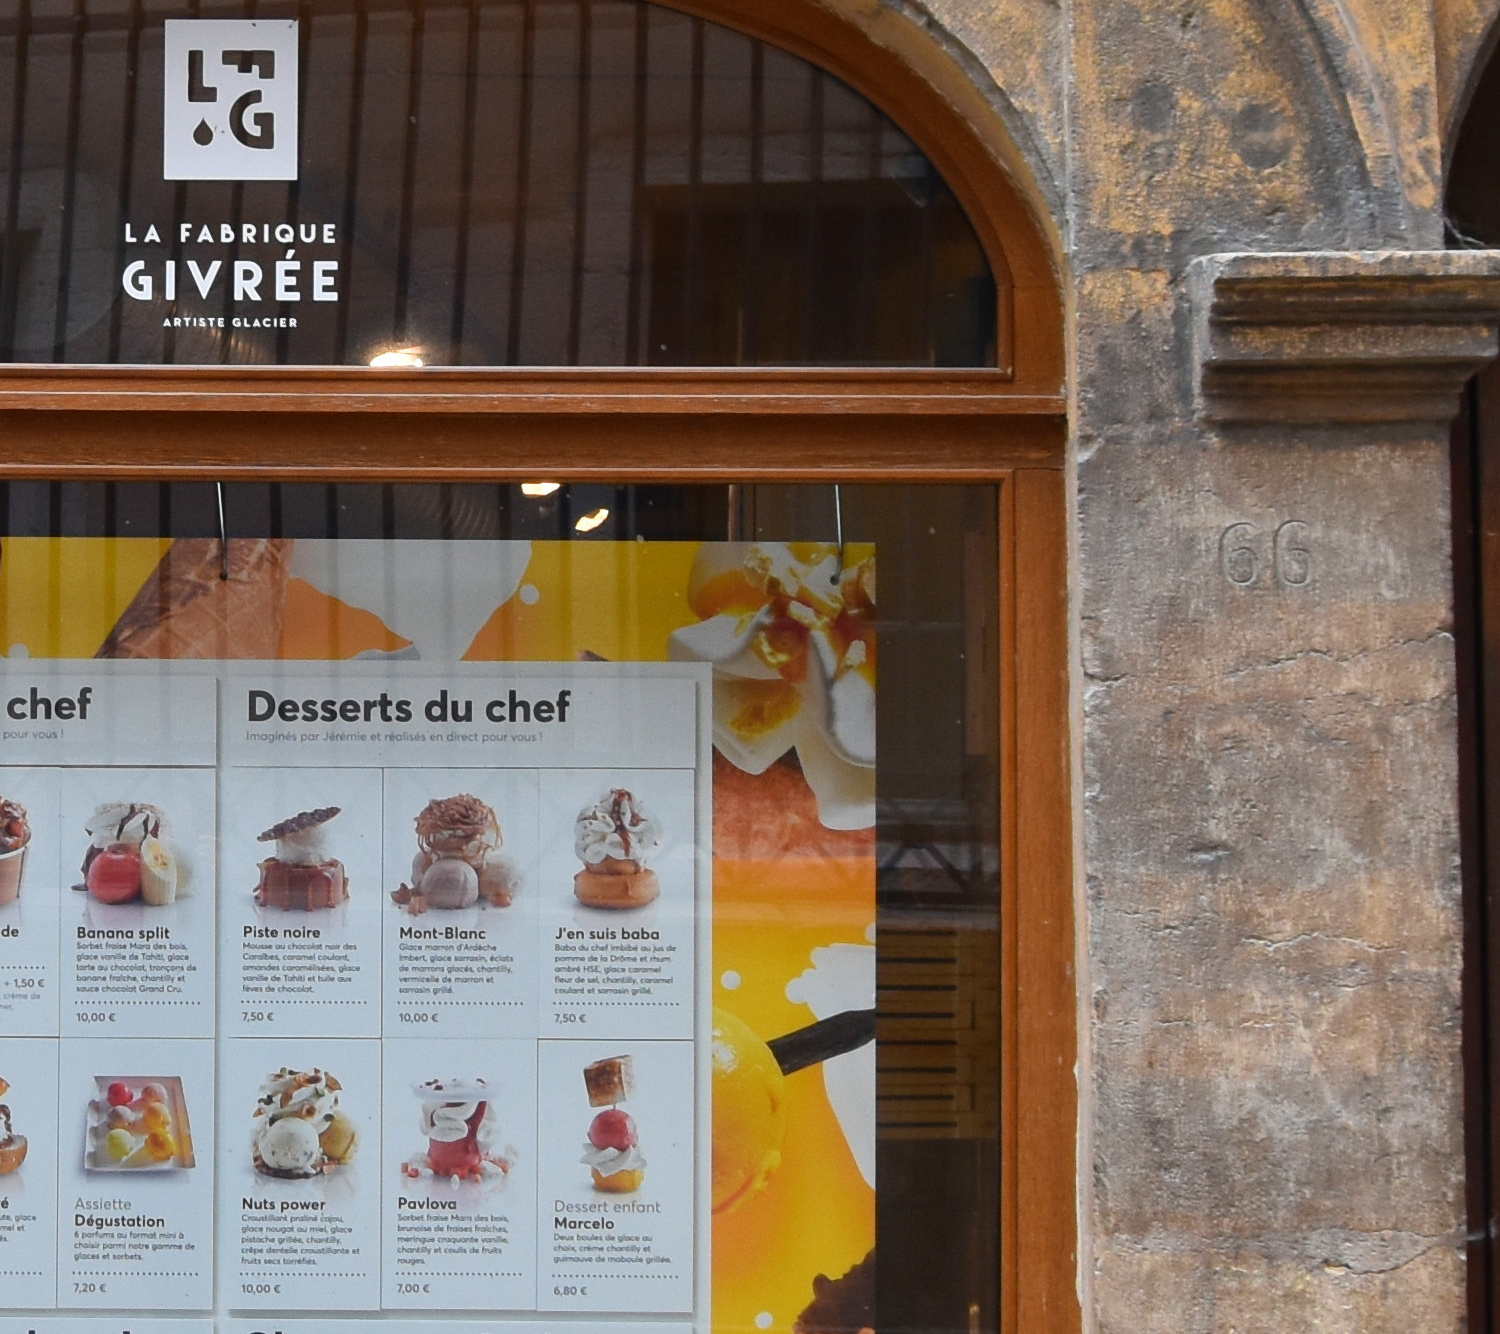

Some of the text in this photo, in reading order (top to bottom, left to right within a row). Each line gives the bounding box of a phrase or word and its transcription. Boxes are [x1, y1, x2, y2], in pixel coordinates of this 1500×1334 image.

[124, 223, 337, 245] LA FABRIQUE
[122, 249, 339, 302] GIVRÉE
[162, 317, 299, 329] ARTISTE GLACIER
[1218, 519, 1315, 587] 66
[7, 687, 92, 719] chef
[249, 690, 571, 722] Desserts du chef
[0, 924, 20, 938] de
[76, 925, 171, 943] Banana split
[243, 925, 321, 939] Piste noire
[399, 926, 487, 940] Mont-Blanc
[554, 926, 660, 941] J'en suis baba
[76, 1012, 117, 1024] 10,00 €
[241, 1011, 275, 1023] 7,50 €
[74, 1196, 132, 1211] Assiette
[242, 1197, 326, 1214] Nuts power
[398, 1196, 457, 1211] Pavlova
[554, 1199, 661, 1214] Dessert enfant
[74, 1213, 165, 1230] Dégustation
[554, 1216, 615, 1230] Marcelo
[73, 1282, 107, 1295] 7,20 €
[241, 1283, 281, 1296] 10,00 €
[553, 1285, 588, 1297] 6,80 €
